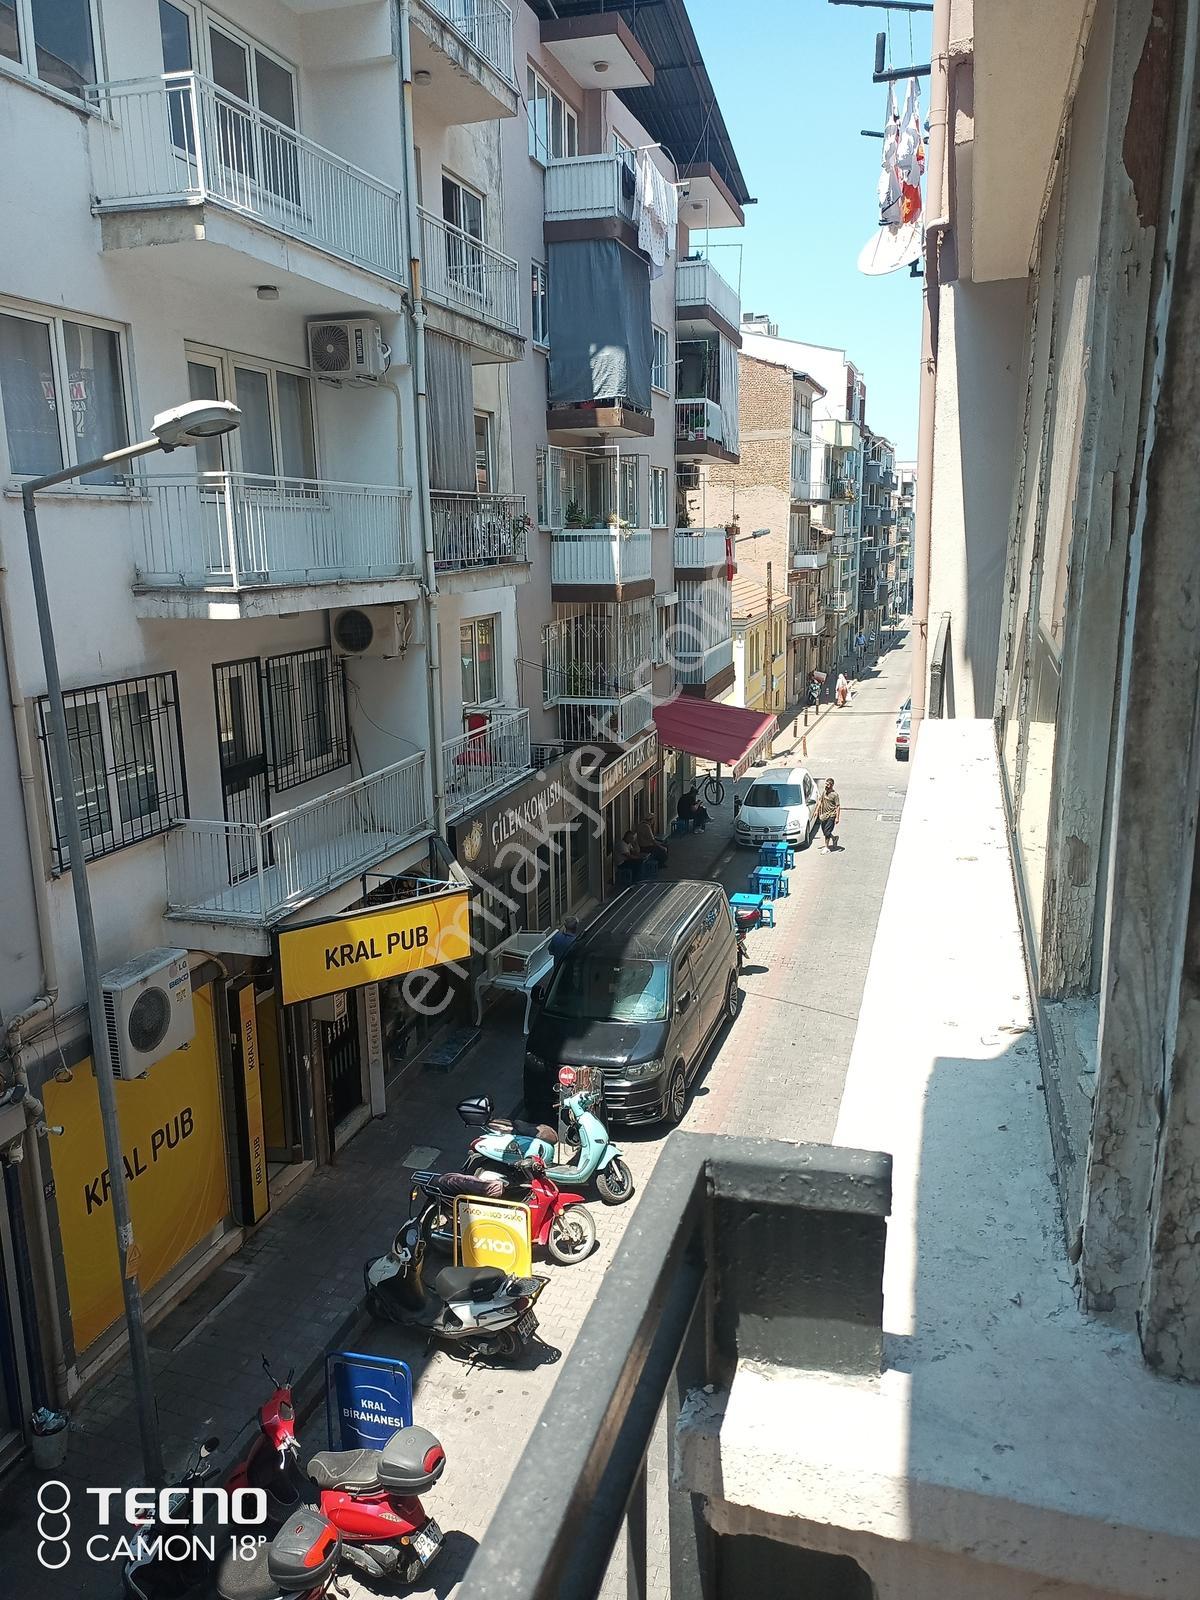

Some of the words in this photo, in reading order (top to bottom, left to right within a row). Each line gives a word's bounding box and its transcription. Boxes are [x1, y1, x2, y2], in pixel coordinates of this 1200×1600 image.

[622, 743, 645, 778] EMLAK
[492, 806, 522, 851] ÇİLEK
[524, 780, 561, 824] KOKUSU
[325, 938, 382, 970] KRAL
[387, 925, 428, 955] PUB
[247, 1042, 255, 1071] KRAL
[151, 1107, 194, 1162] PUB
[253, 1136, 261, 1159] PUB
[255, 1159, 263, 1186] KRAL
[343, 1407, 404, 1428] BİRAHANESİ
[361, 1399, 386, 1412] KRAL
[417, 1536, 425, 1551] 09
